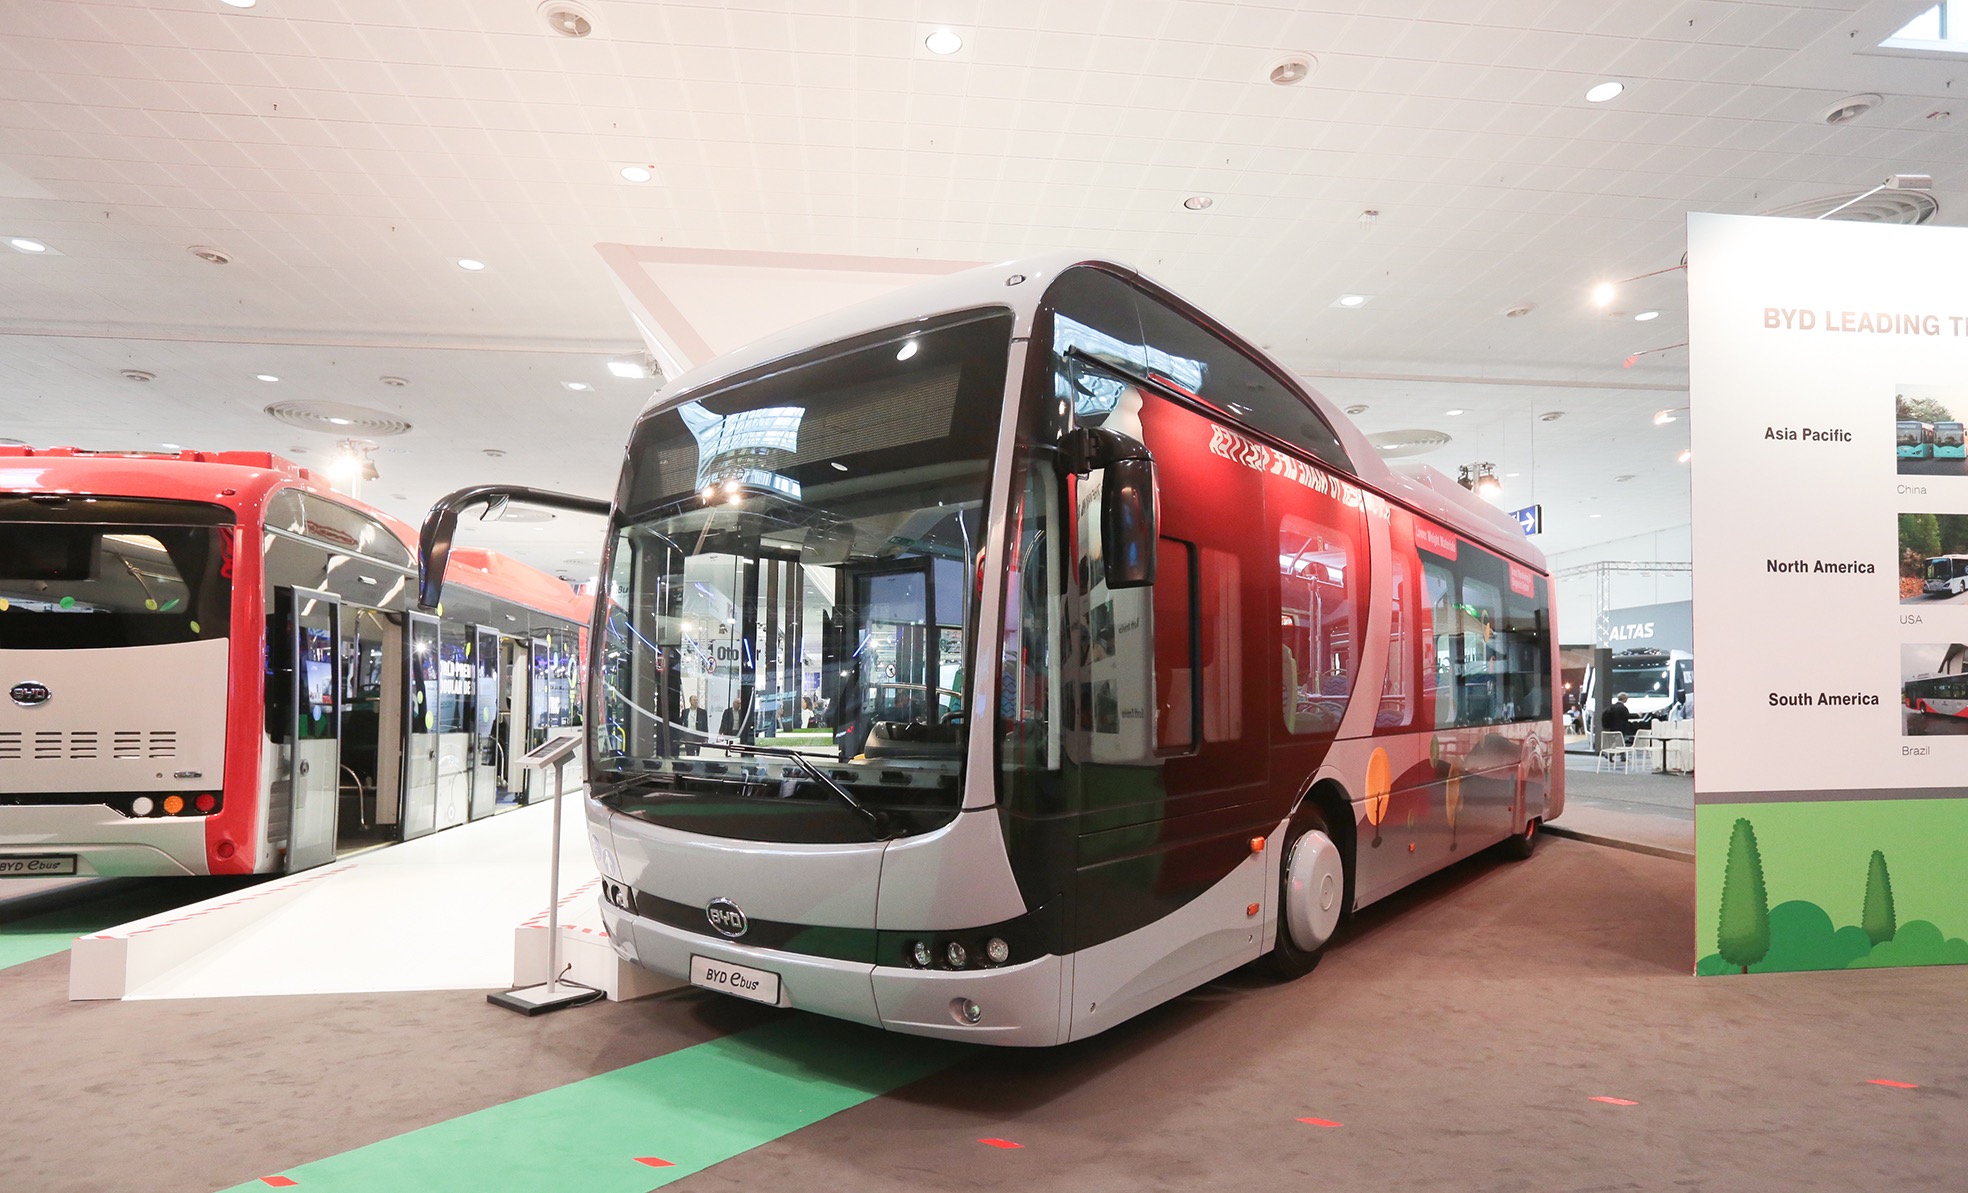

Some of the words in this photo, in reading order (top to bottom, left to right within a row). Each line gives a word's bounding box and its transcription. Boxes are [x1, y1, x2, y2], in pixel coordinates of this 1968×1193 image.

[1764, 307, 1816, 330] BYD
[1825, 310, 1940, 336] LEADING
[1764, 426, 1797, 441] Asia
[1802, 427, 1852, 442] Pacific
[1896, 484, 1927, 495] China
[1766, 559, 1809, 573] North
[1813, 560, 1876, 574] America
[1899, 614, 1923, 625] USA
[1609, 622, 1655, 641] ALTAS
[13, 687, 46, 700] BYD
[1768, 692, 1813, 707] South
[1817, 692, 1880, 706] America
[1901, 745, 1931, 756] Brazil
[0, 862, 24, 871] BYD
[709, 907, 742, 928] BYD
[706, 968, 727, 984] BYD
